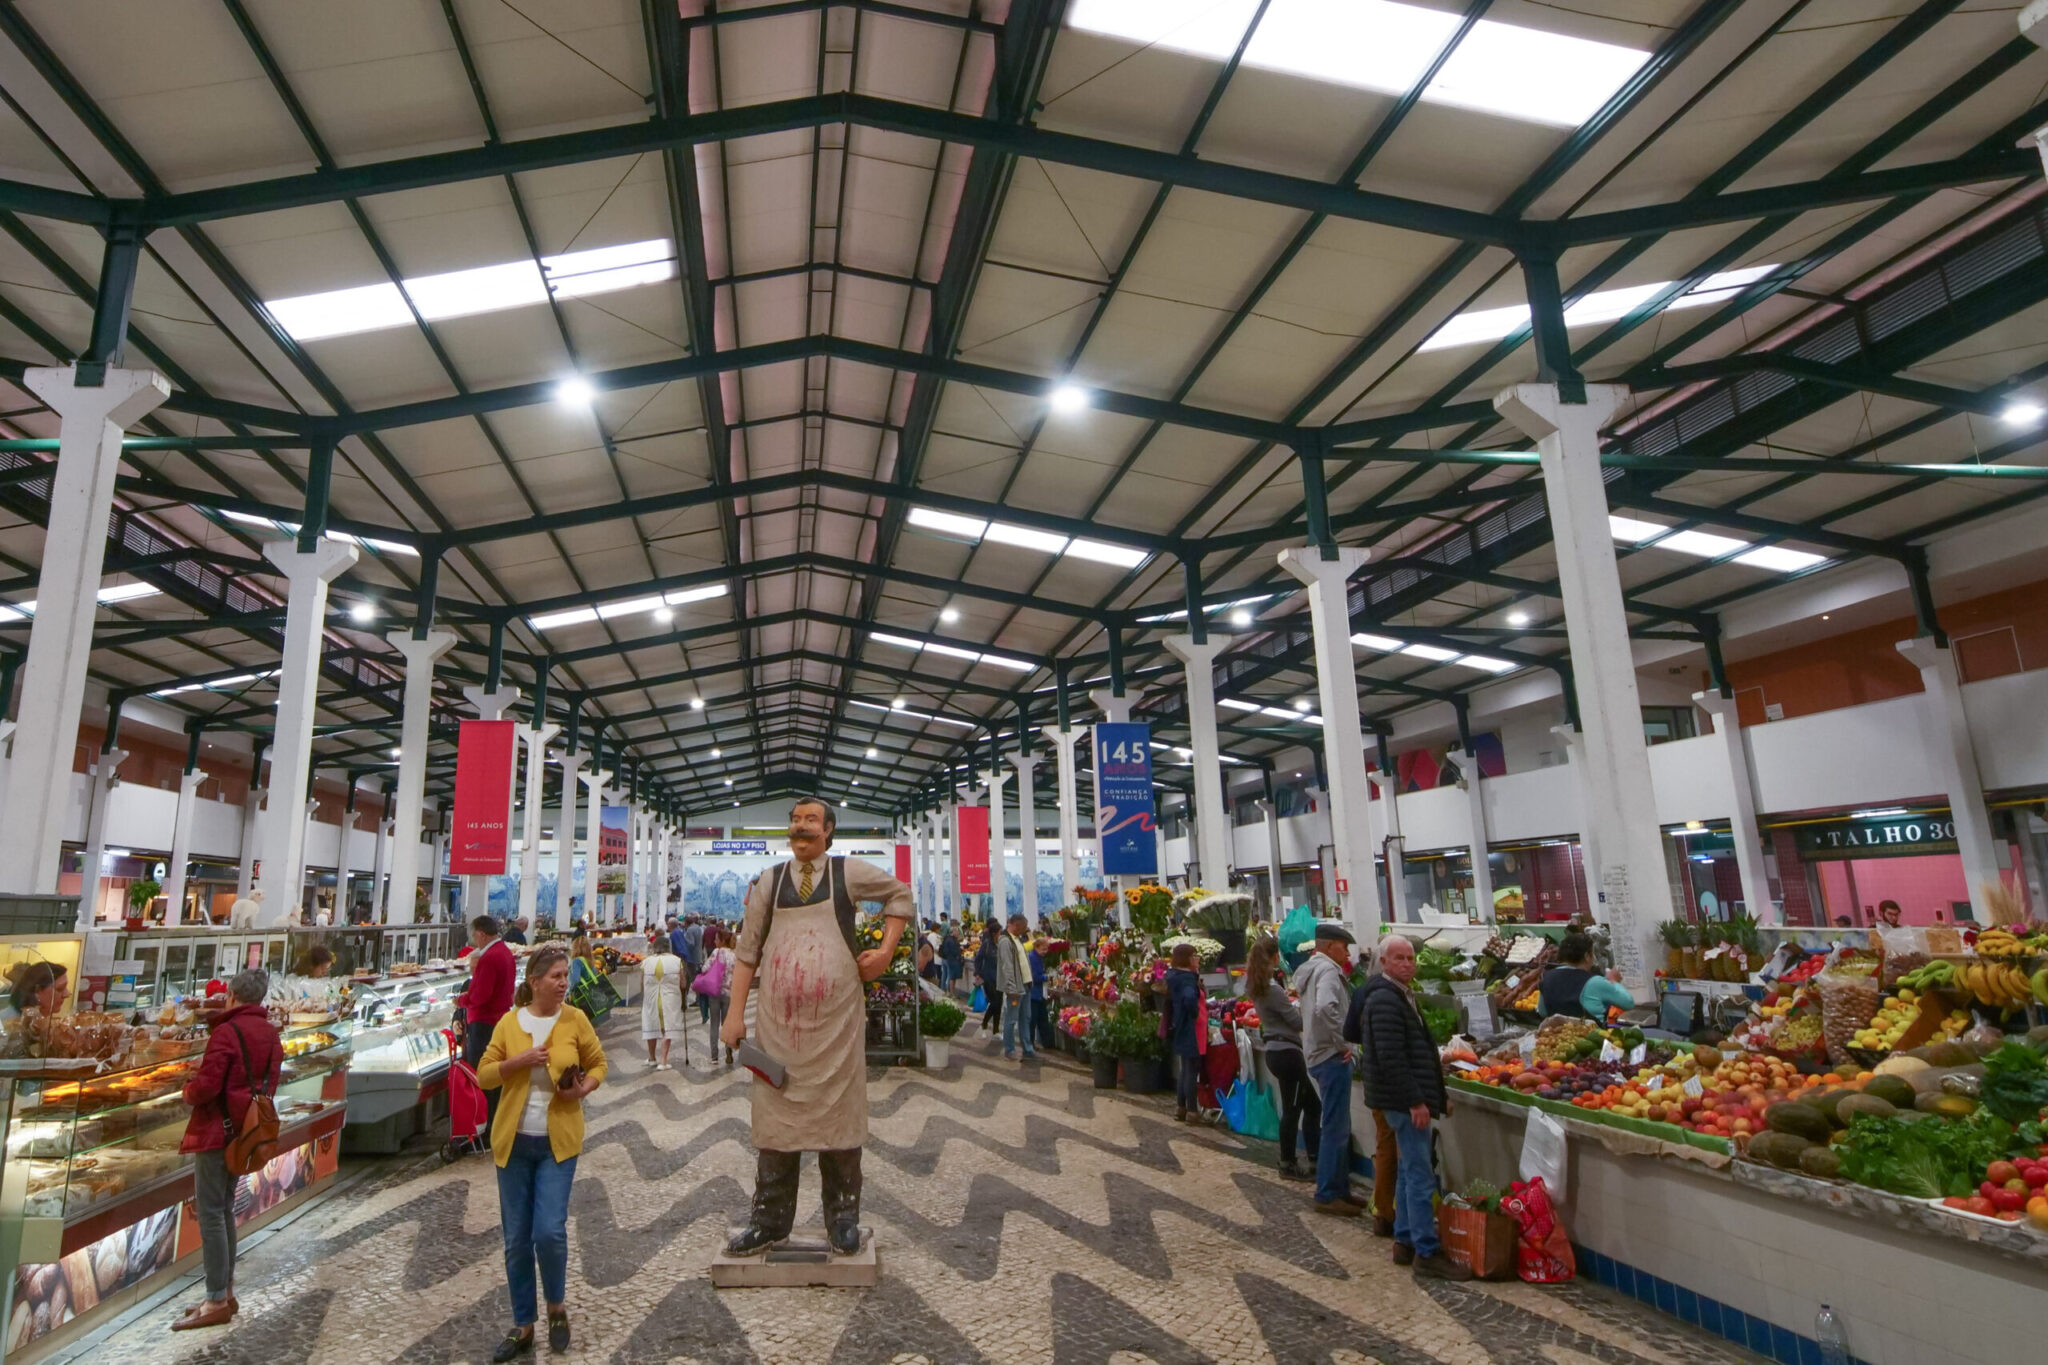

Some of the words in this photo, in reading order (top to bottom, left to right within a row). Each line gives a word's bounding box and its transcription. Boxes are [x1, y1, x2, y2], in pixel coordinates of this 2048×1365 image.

[1102, 741, 1145, 764] 145
[1104, 764, 1147, 774] ANOS
[1111, 793, 1149, 801] TRADIÇÃO
[1827, 824, 1922, 847] TALHO
